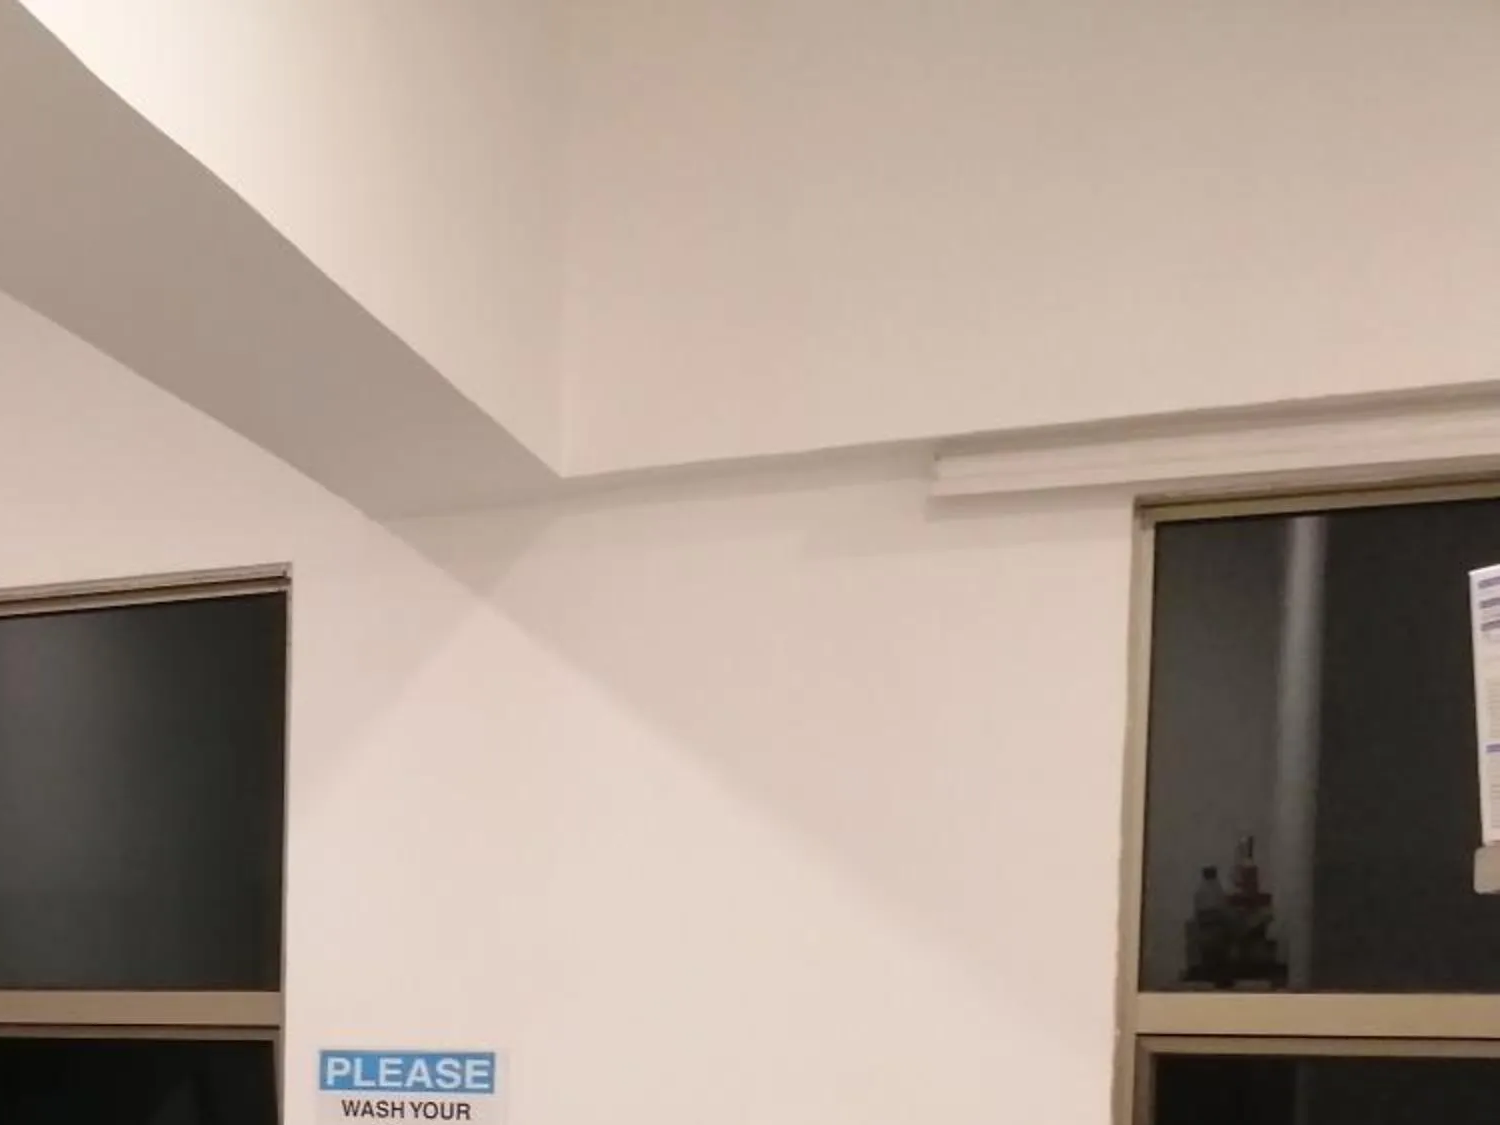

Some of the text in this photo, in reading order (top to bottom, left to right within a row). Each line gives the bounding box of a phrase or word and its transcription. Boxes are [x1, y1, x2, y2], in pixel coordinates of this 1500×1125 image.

[326, 1056, 491, 1089] PLEASE
[341, 1099, 472, 1121] WASH YOUR
